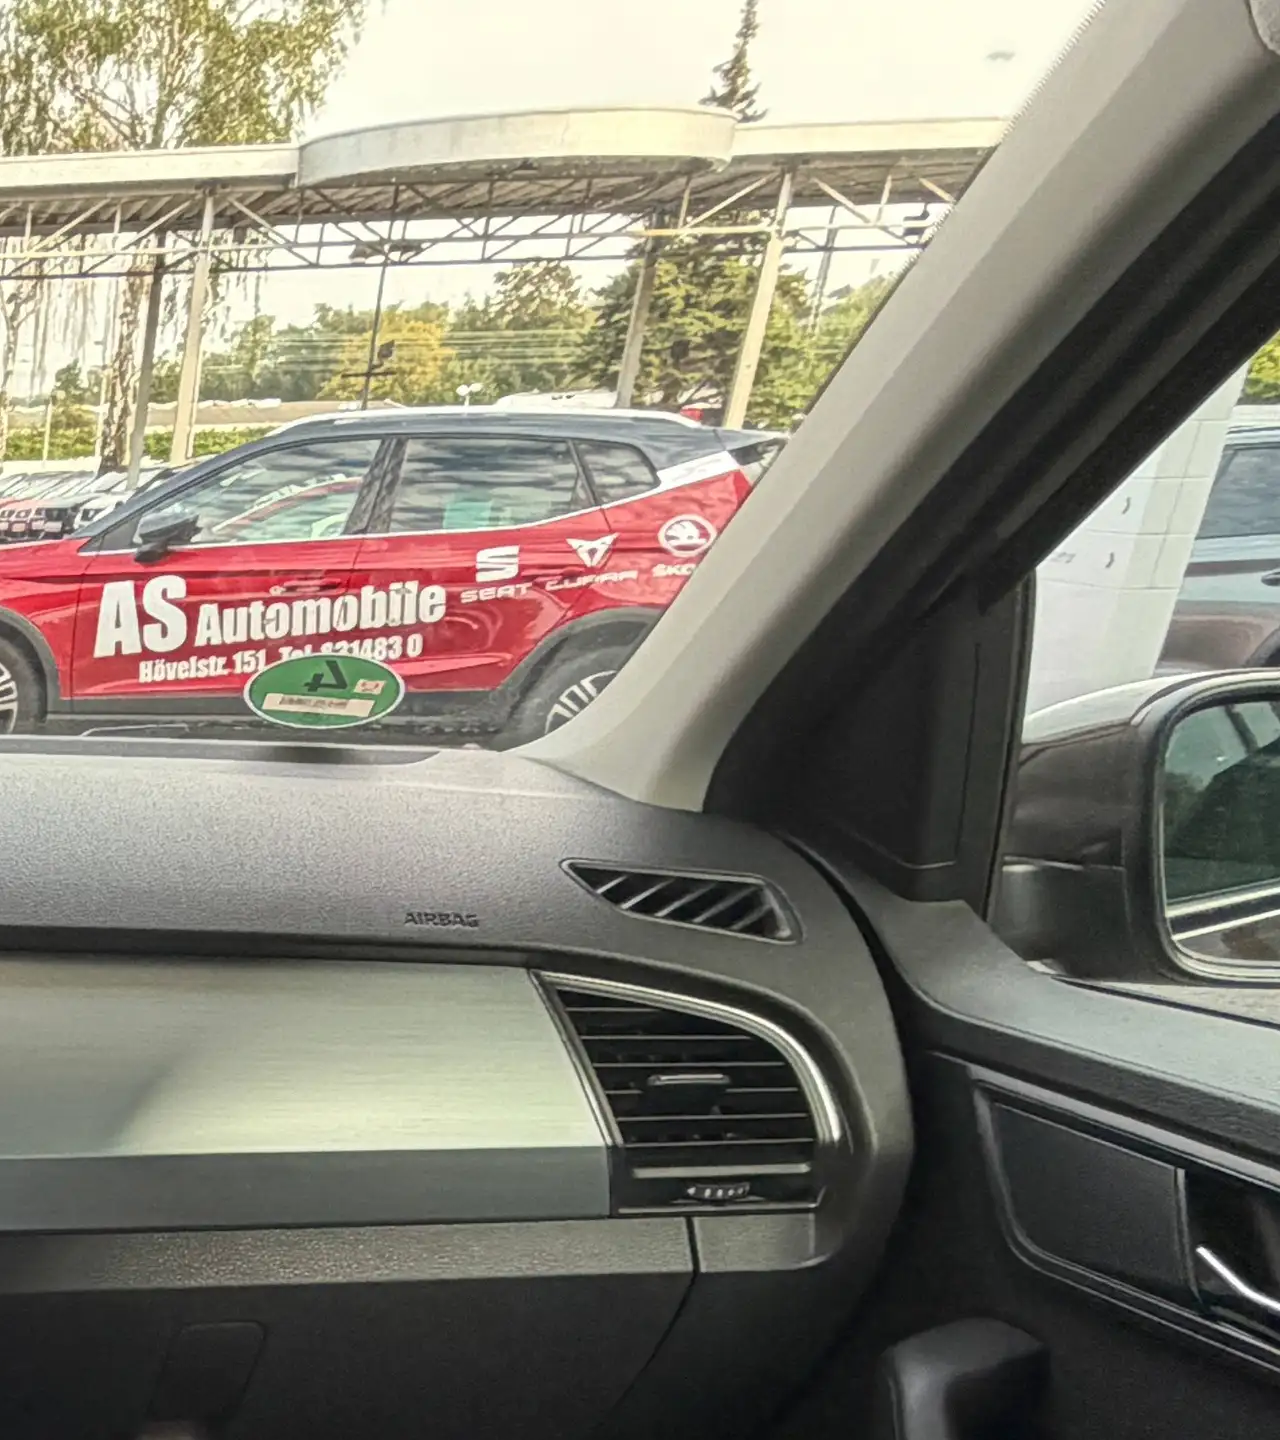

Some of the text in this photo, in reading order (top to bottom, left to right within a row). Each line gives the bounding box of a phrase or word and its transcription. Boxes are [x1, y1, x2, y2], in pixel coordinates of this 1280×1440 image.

[545, 570, 638, 592] CUPRA
[460, 583, 533, 604] SEAT
[93, 574, 447, 658] AS Automobile
[232, 649, 267, 674] 151
[404, 911, 480, 928] AIRBAG
